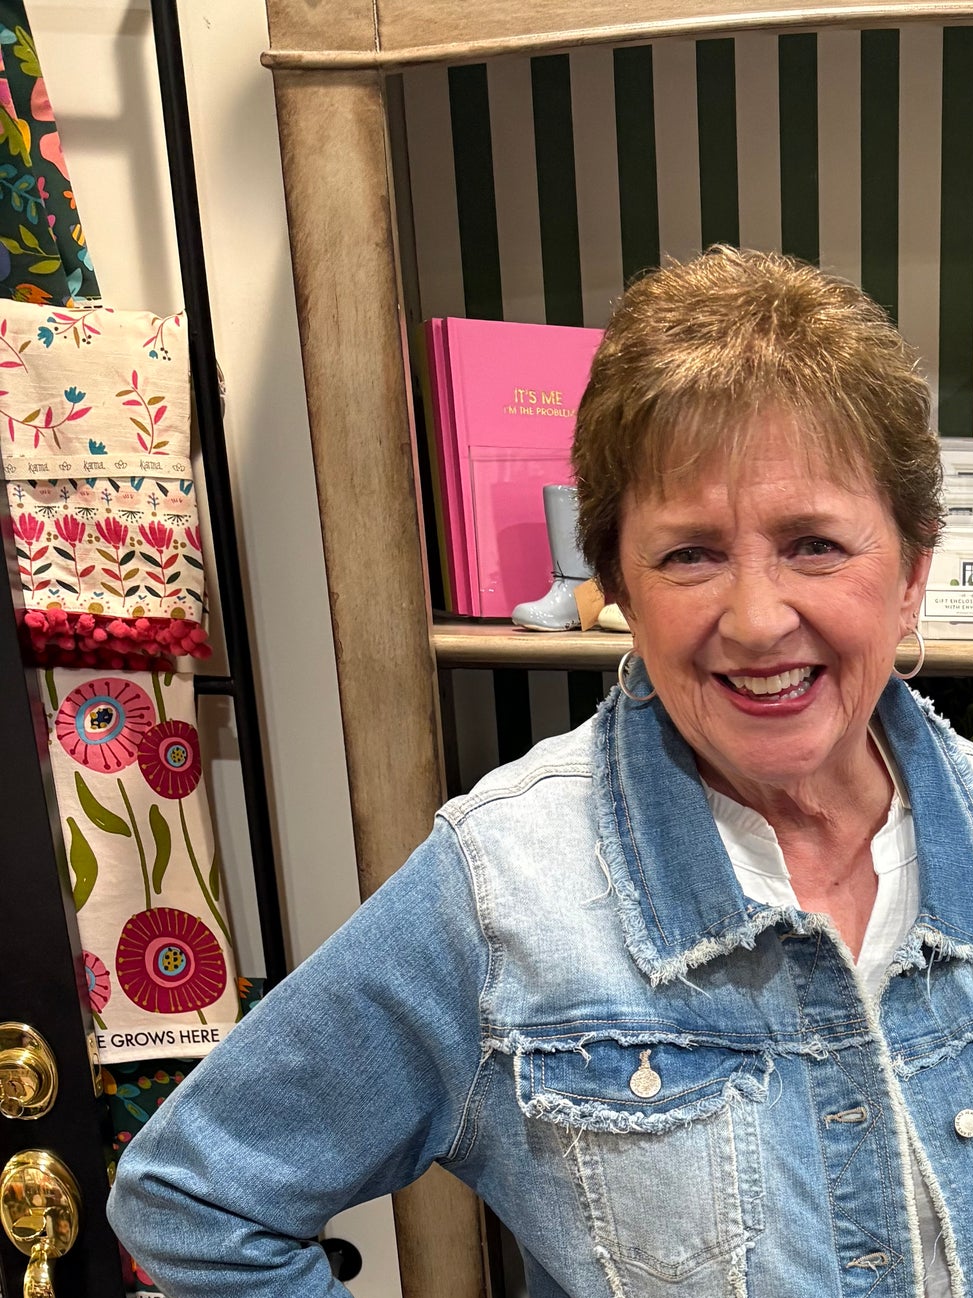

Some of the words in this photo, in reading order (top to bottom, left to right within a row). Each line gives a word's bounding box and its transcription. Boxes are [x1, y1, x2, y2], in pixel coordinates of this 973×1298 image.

[514, 388, 537, 404] IT'S
[541, 390, 562, 405] ME
[519, 407, 534, 416] THE
[83, 460, 106, 472] karma
[140, 459, 163, 472] karma
[111, 1031, 176, 1048] GROWS
[179, 1028, 220, 1044] HERE
